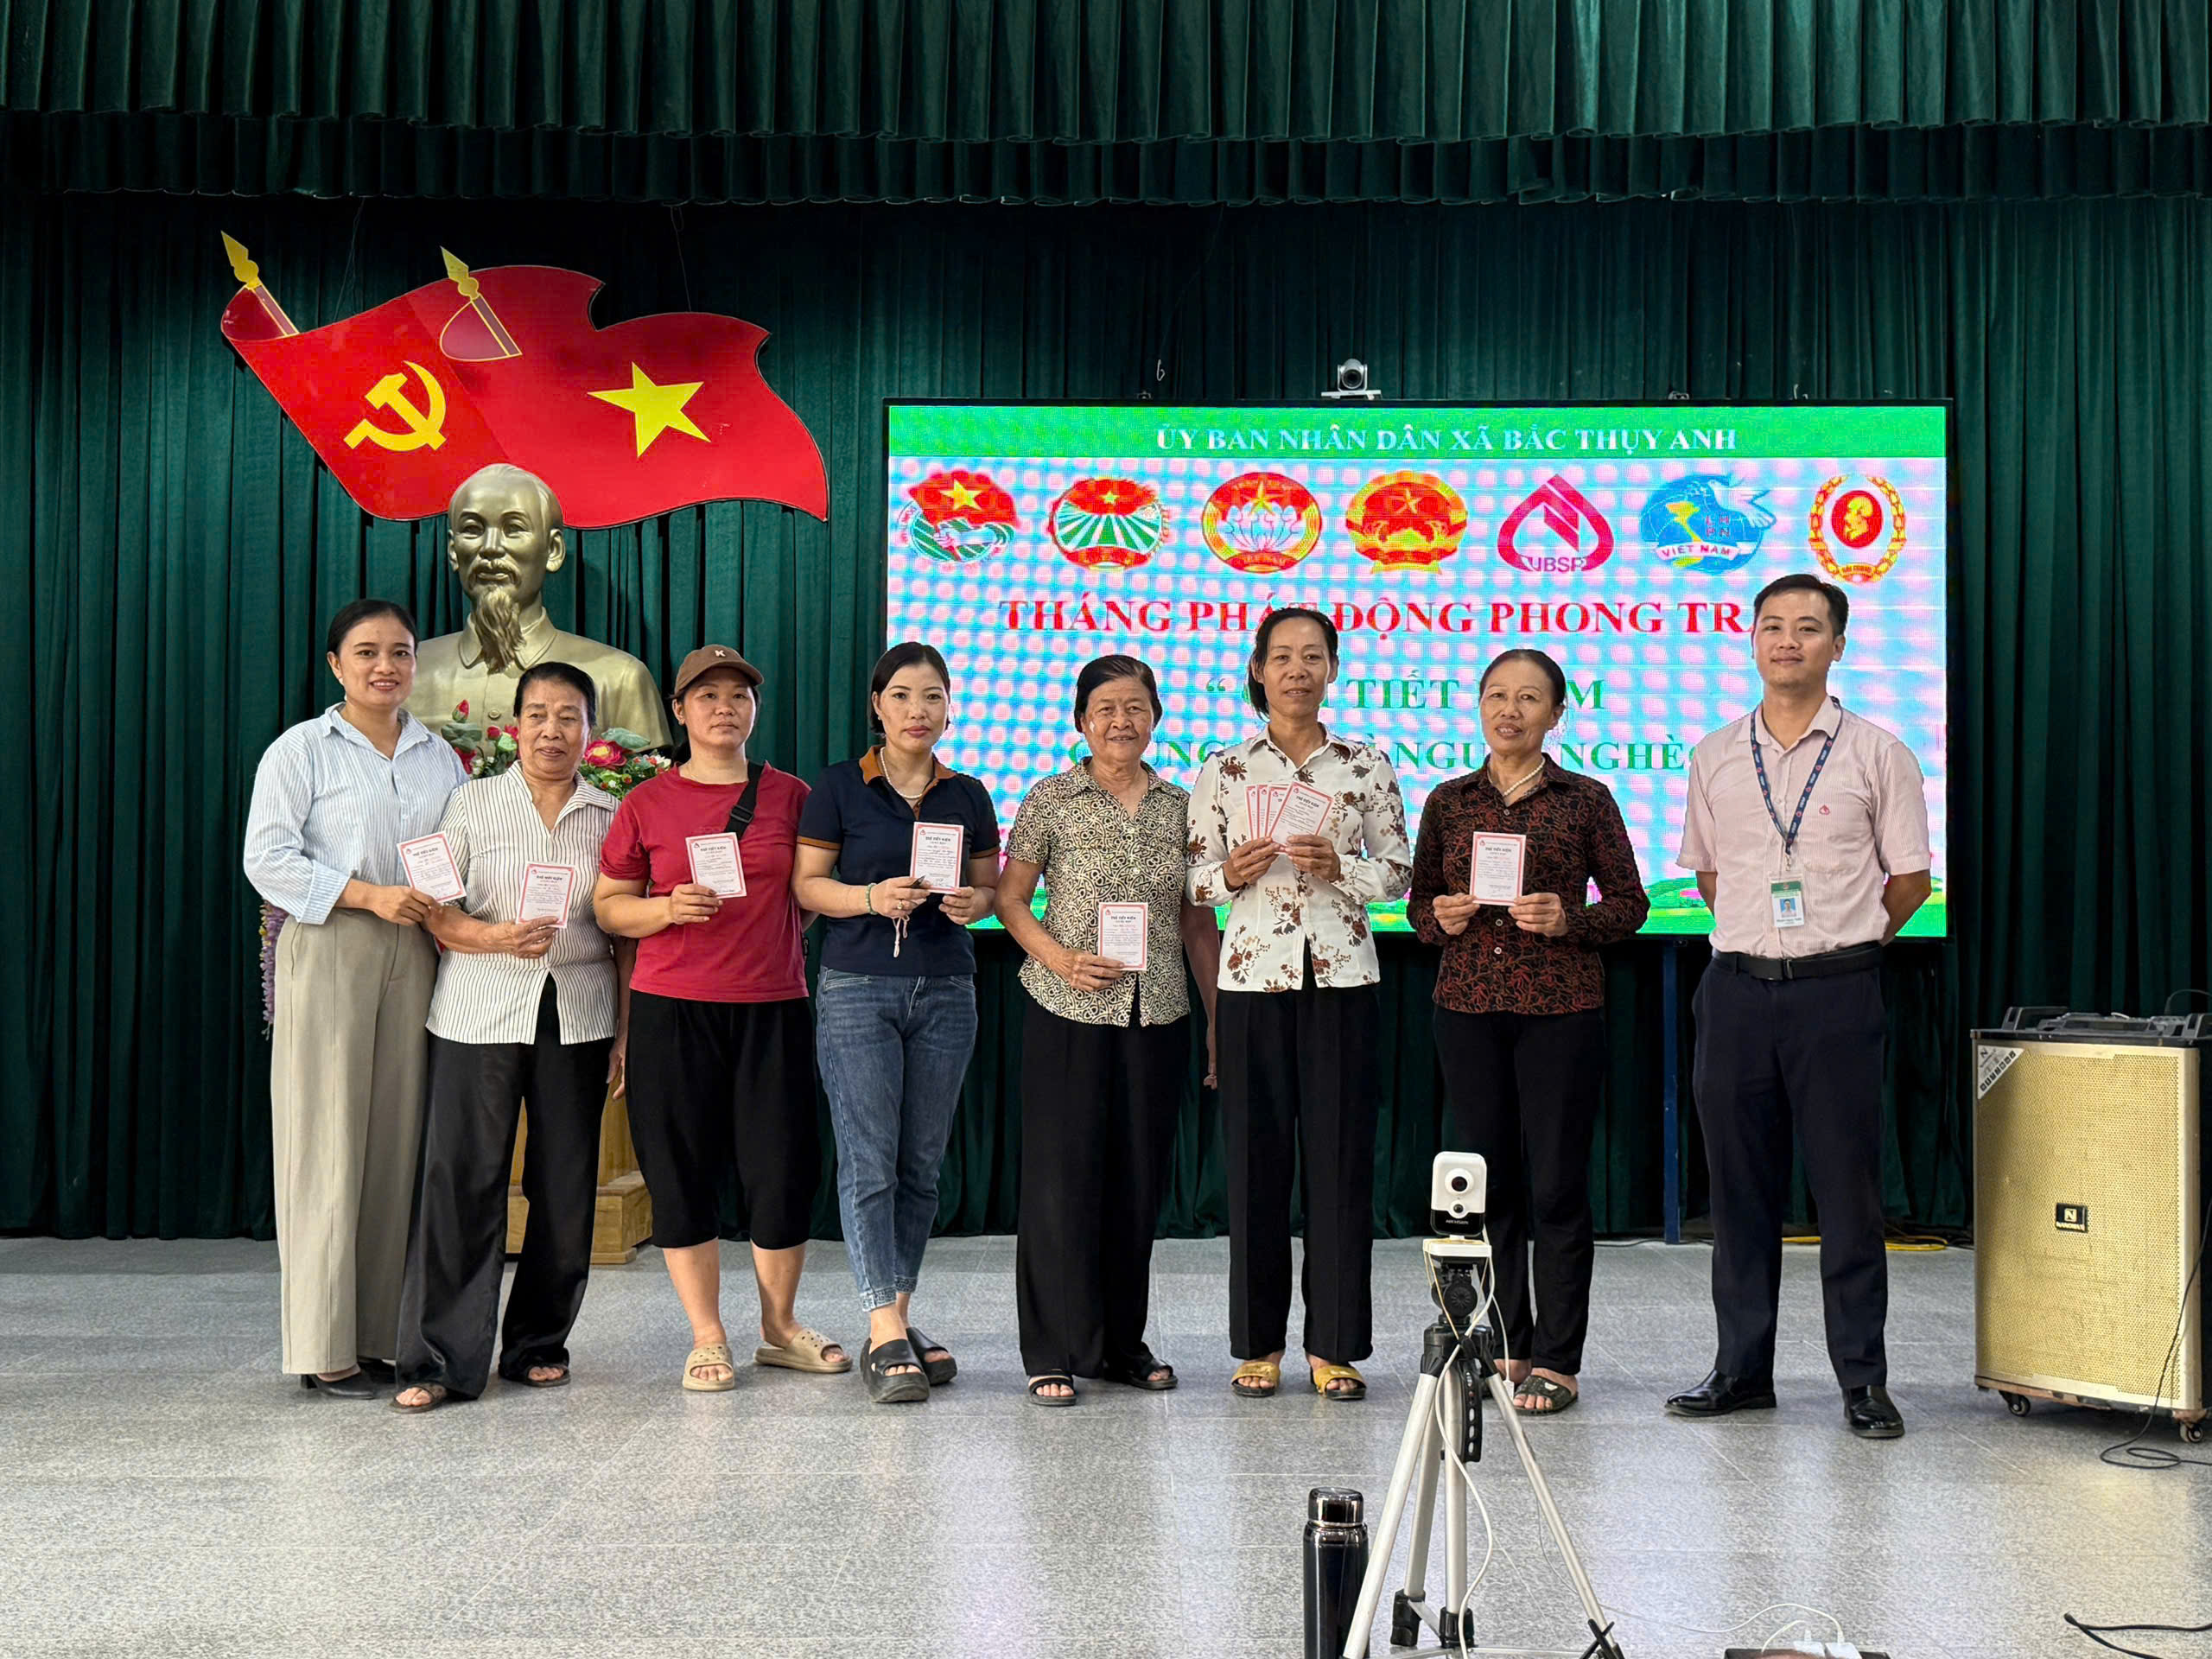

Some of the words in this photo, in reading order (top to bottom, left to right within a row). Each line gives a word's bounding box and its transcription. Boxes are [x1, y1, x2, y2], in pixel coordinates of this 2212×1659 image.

[1206, 429, 1269, 449] BAN
[1280, 423, 1367, 449] NHÂN
[1376, 423, 1442, 449] DÂN
[1451, 425, 1493, 449] XÃ
[1503, 423, 1567, 449] BẮC
[1575, 429, 1663, 455] THỤY
[1669, 429, 1737, 449] ANH
[1700, 544, 1732, 556] NAM
[999, 591, 1174, 632] THÁNG
[1330, 597, 1476, 640] ĐỘNG
[1488, 602, 1665, 632] PHONG
[1677, 602, 1754, 632] TR
[1346, 669, 1460, 709] TIẾT
[1558, 734, 1696, 771] NGHÈ
